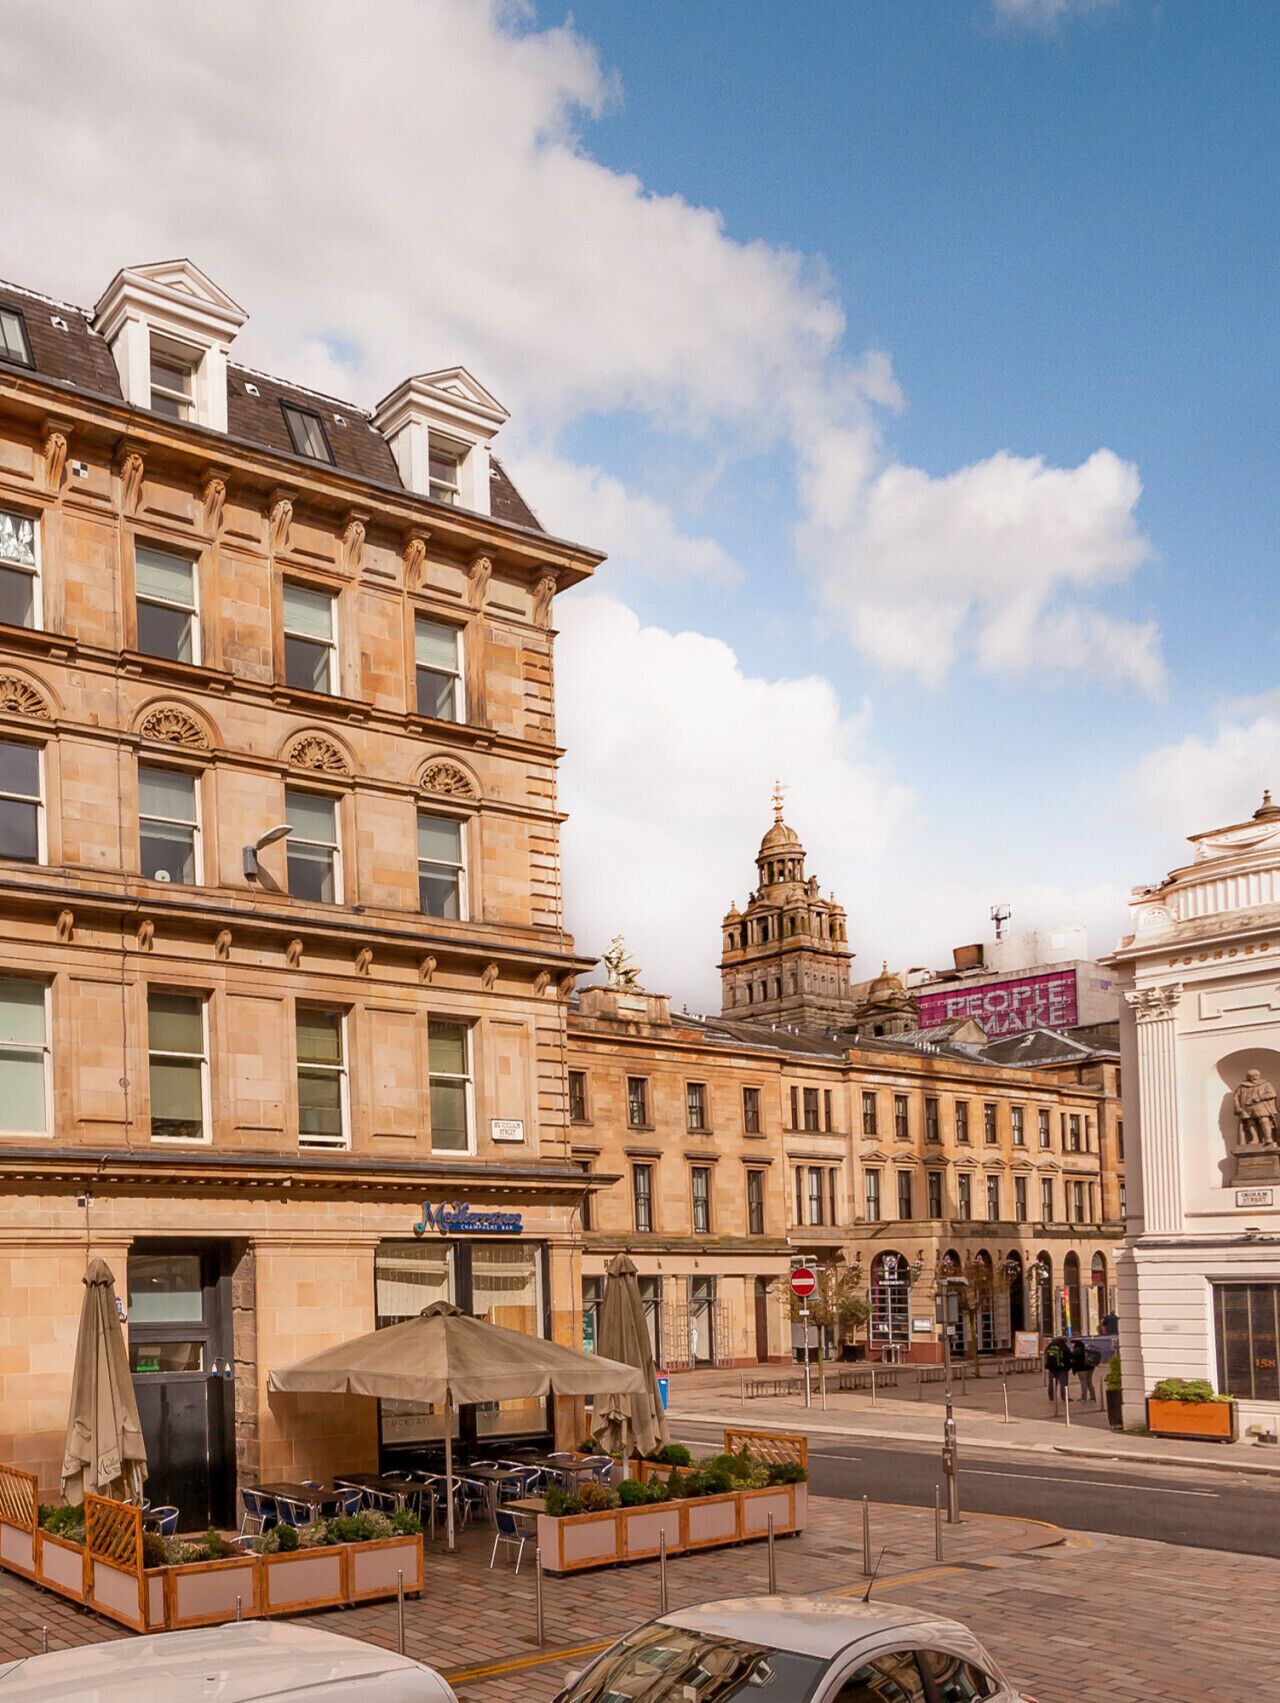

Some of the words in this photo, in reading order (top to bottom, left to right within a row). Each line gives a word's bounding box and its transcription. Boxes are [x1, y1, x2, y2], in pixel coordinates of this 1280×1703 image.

[1168, 942, 1270, 968] FOUNDED
[945, 979, 1063, 1019] PEOPLE
[974, 1004, 1063, 1034] MAKE
[460, 1223, 498, 1231] CHAMPAGNE
